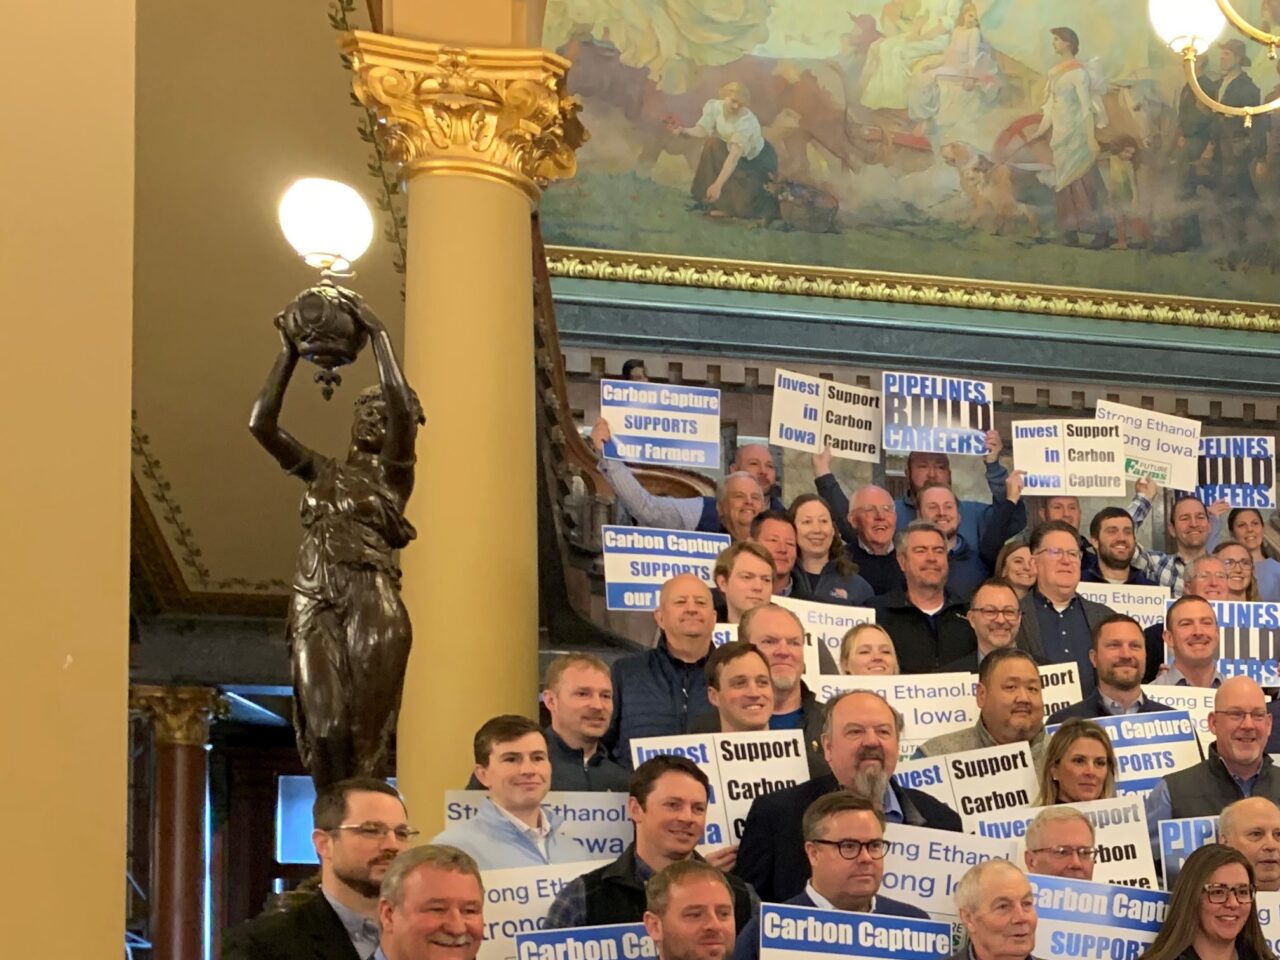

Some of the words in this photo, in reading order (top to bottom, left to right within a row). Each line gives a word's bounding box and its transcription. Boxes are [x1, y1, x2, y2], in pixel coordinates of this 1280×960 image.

[777, 374, 820, 396] Invest
[603, 384, 657, 404] Carbon
[660, 389, 718, 409] Capture
[827, 385, 880, 408] Support
[803, 404, 818, 421] in
[825, 410, 872, 431] Carbon
[884, 395, 990, 433] BUILD
[624, 415, 698, 434] SUPPORTS
[779, 423, 816, 446] Iowa
[1015, 425, 1058, 438] Invest
[1066, 423, 1119, 439] Support
[1147, 419, 1198, 439] Ethanol.
[644, 443, 705, 463] Farmers
[823, 434, 876, 454] Capture
[1156, 438, 1197, 458] Iowa.
[1045, 447, 1060, 462] in
[1067, 448, 1115, 462] Carbon
[1139, 463, 1168, 474] FUTURE
[1198, 455, 1272, 488] UILD
[1069, 473, 1122, 489] Capture
[605, 531, 664, 549] Carbon
[624, 592, 652, 606] our
[894, 683, 971, 699] Ethanol.
[914, 708, 973, 725] Iowa.
[1120, 717, 1192, 741] Capture
[720, 738, 801, 762] Support
[951, 750, 1028, 780] Support
[961, 789, 1029, 816] Carbon
[763, 912, 853, 944] Carbon
[858, 922, 950, 953] Capture
